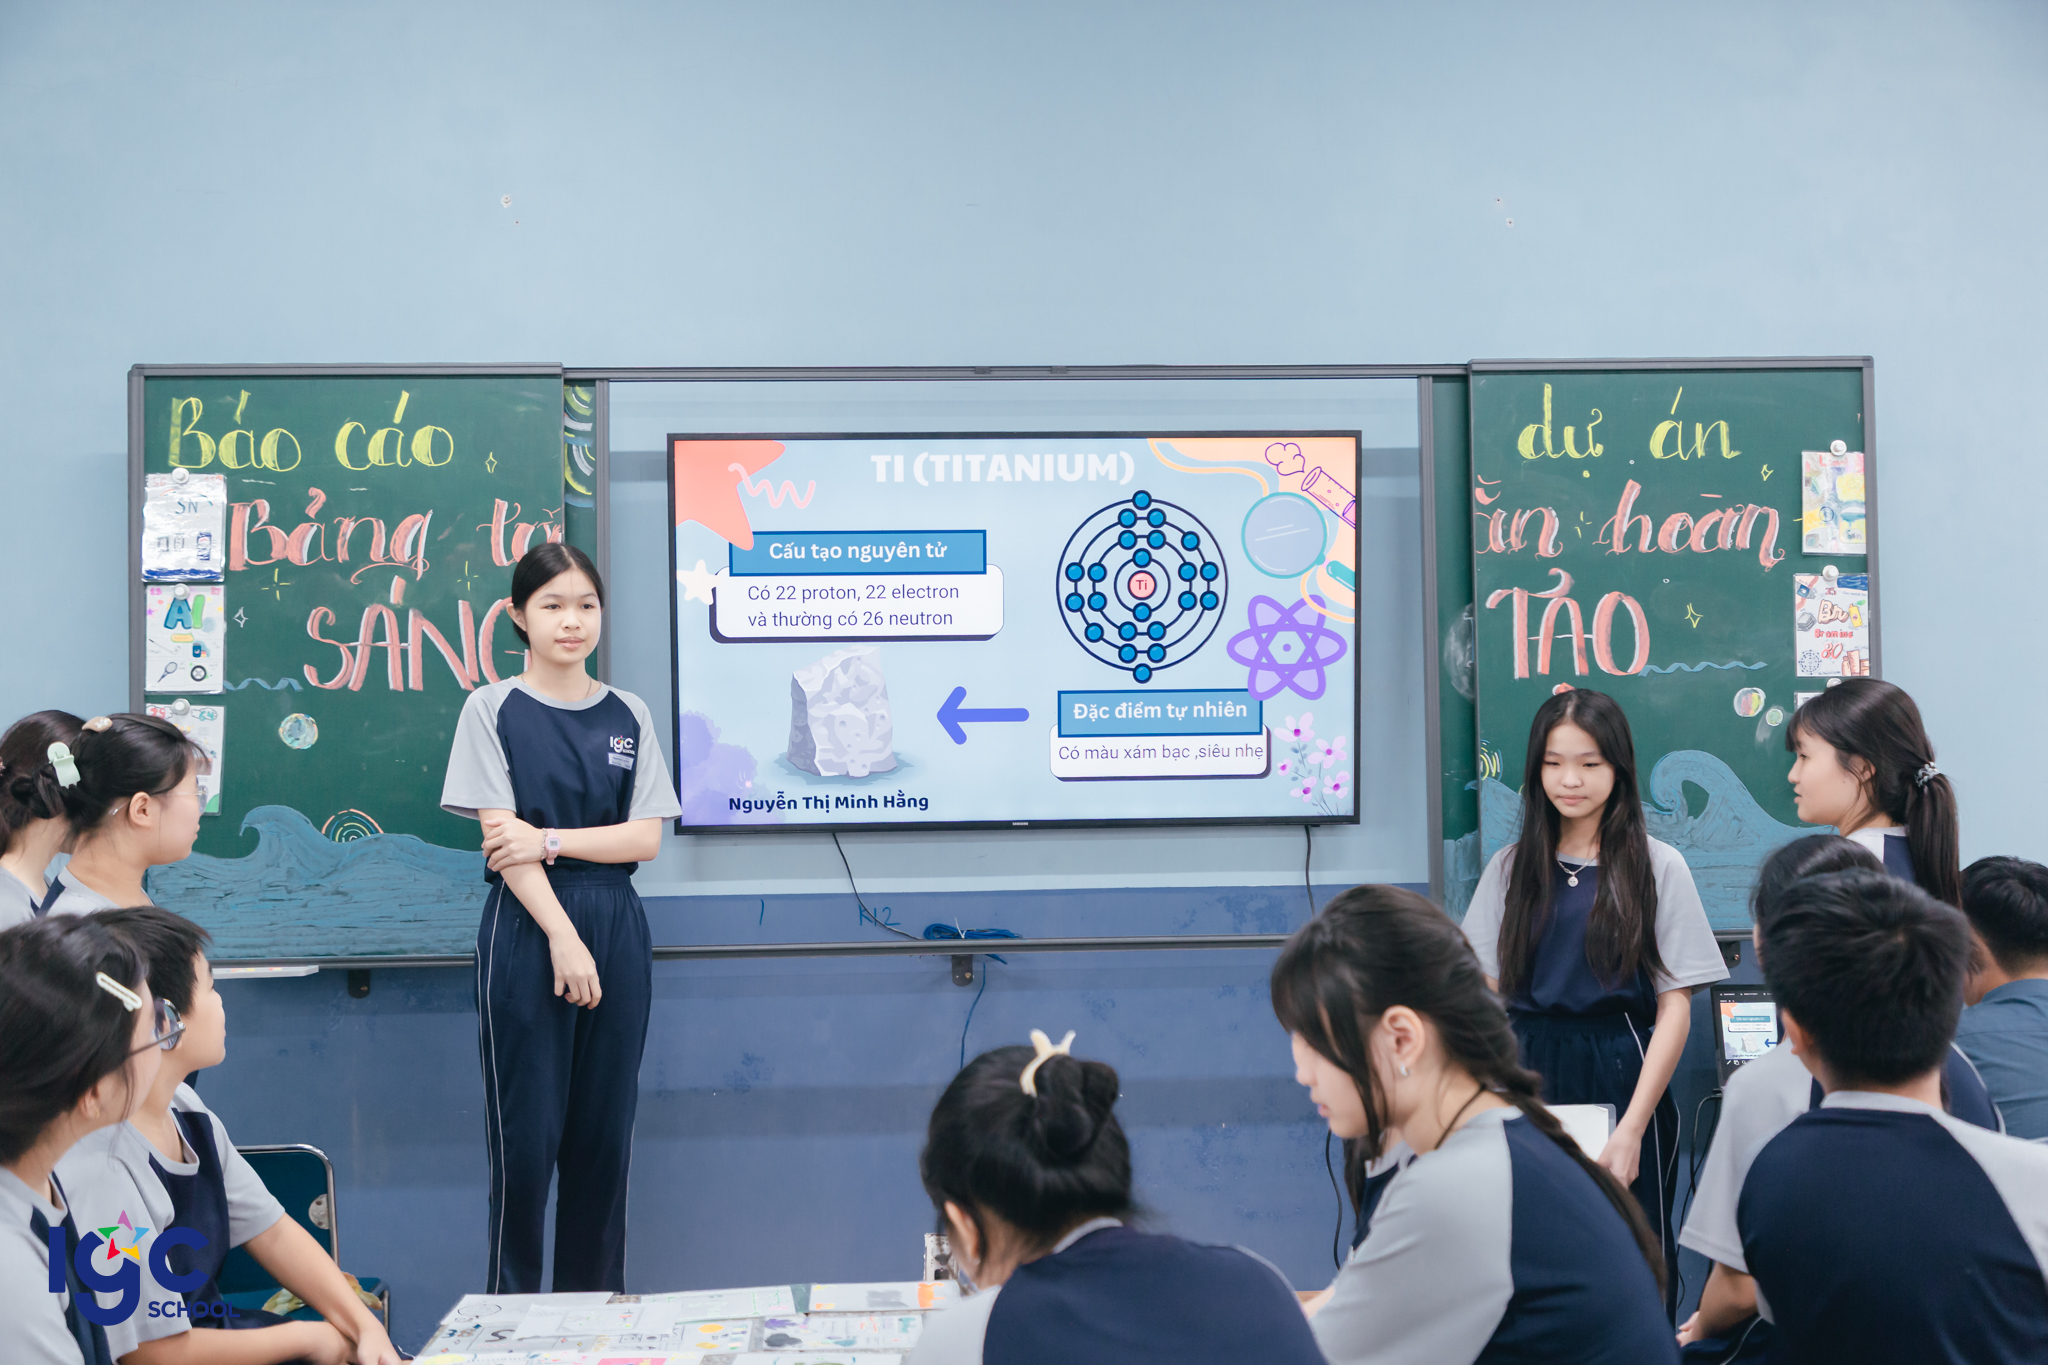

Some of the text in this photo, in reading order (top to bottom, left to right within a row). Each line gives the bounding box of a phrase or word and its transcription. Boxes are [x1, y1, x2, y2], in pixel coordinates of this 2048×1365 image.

[168, 389, 454, 471] Báo cáo
[1518, 383, 1742, 478] dự án
[871, 451, 1135, 486] TI (TITANIUM)
[229, 487, 434, 585] Bảng
[769, 541, 948, 563] Cấu tạo nguyên tử
[748, 583, 959, 603] Có 22 proton, 22 electron
[1136, 579, 1148, 591] Ti
[748, 610, 953, 630] và thường có 26 neutron
[1818, 599, 1850, 625] Br
[1814, 628, 1854, 639] Bromine
[1821, 643, 1843, 659] 80
[199, 710, 215, 722] 64
[1073, 701, 1248, 723] Đặc điểm tự nhiên
[1058, 745, 1080, 760] Có
[1085, 745, 1119, 760] màu
[1124, 744, 1157, 759] xám
[1162, 743, 1190, 762] bạc
[1235, 742, 1263, 760] nhẹ
[729, 789, 929, 813] Nguyễn Thị Minh Hằng
